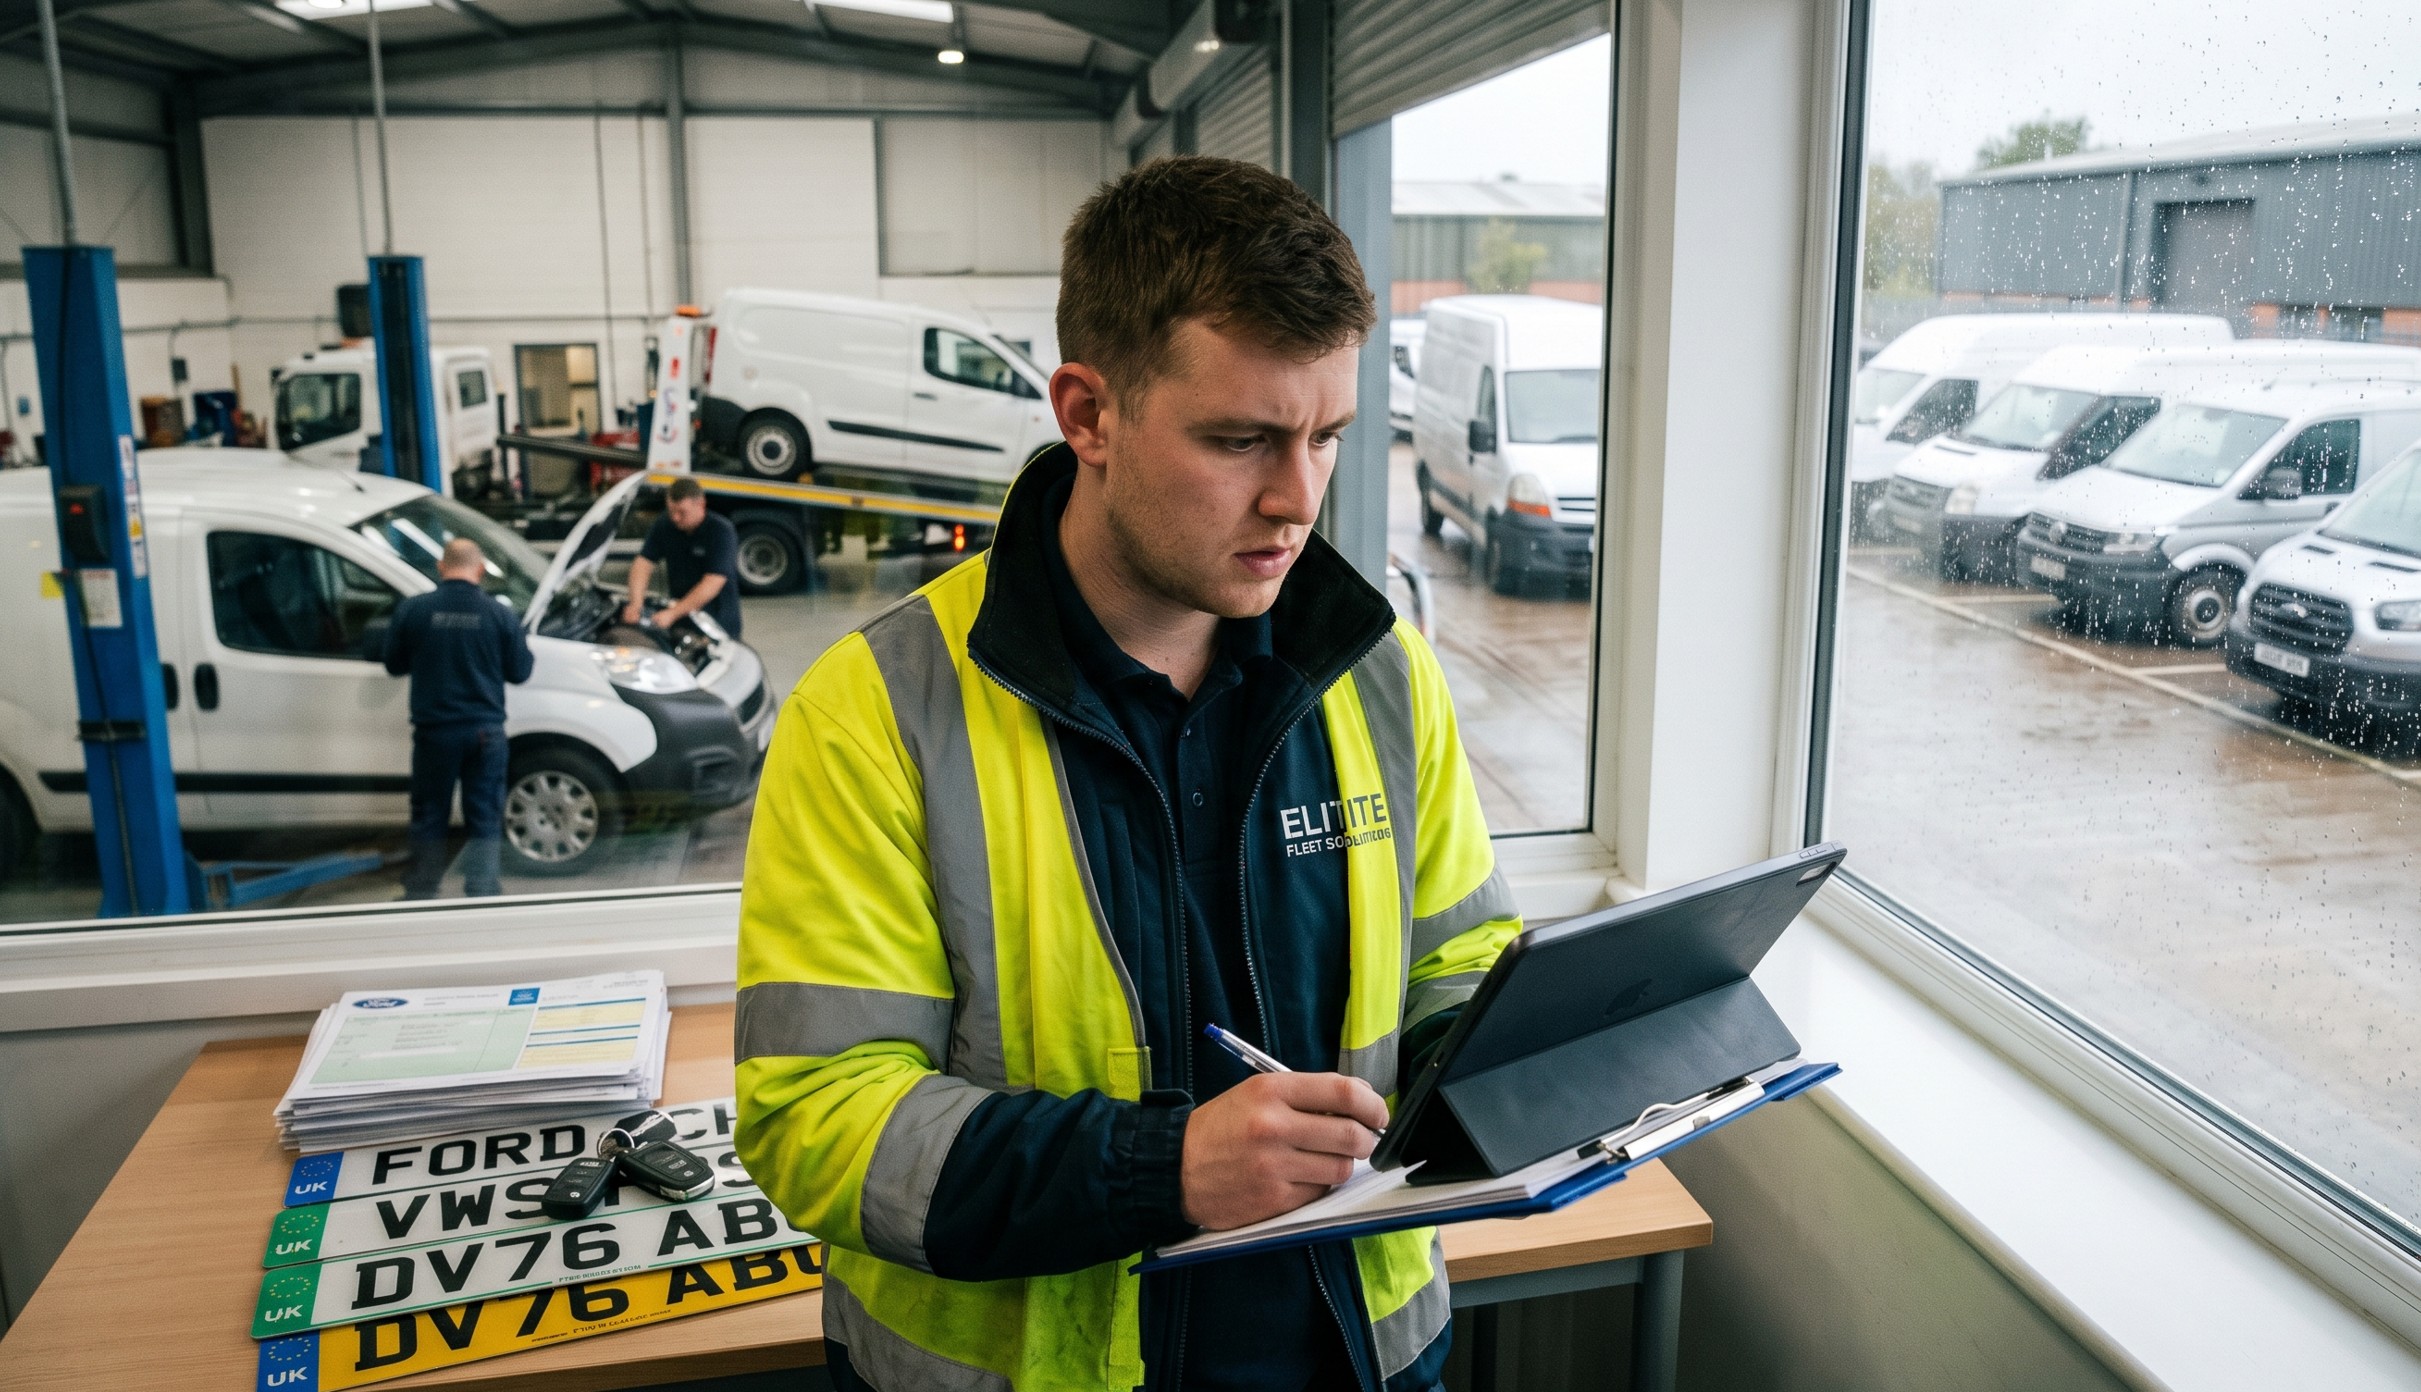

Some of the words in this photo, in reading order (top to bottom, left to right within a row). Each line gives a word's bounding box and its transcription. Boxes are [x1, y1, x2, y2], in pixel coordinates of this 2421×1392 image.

[1286, 839, 1323, 858] FLEET
[372, 1125, 586, 1186] FORD
[294, 1180, 328, 1195] UK
[275, 1238, 313, 1256] UK
[351, 1223, 620, 1311] DV76
[657, 1198, 805, 1257] AB
[264, 1304, 304, 1323] UK
[354, 1276, 630, 1372] DV76
[267, 1366, 308, 1388] UK
